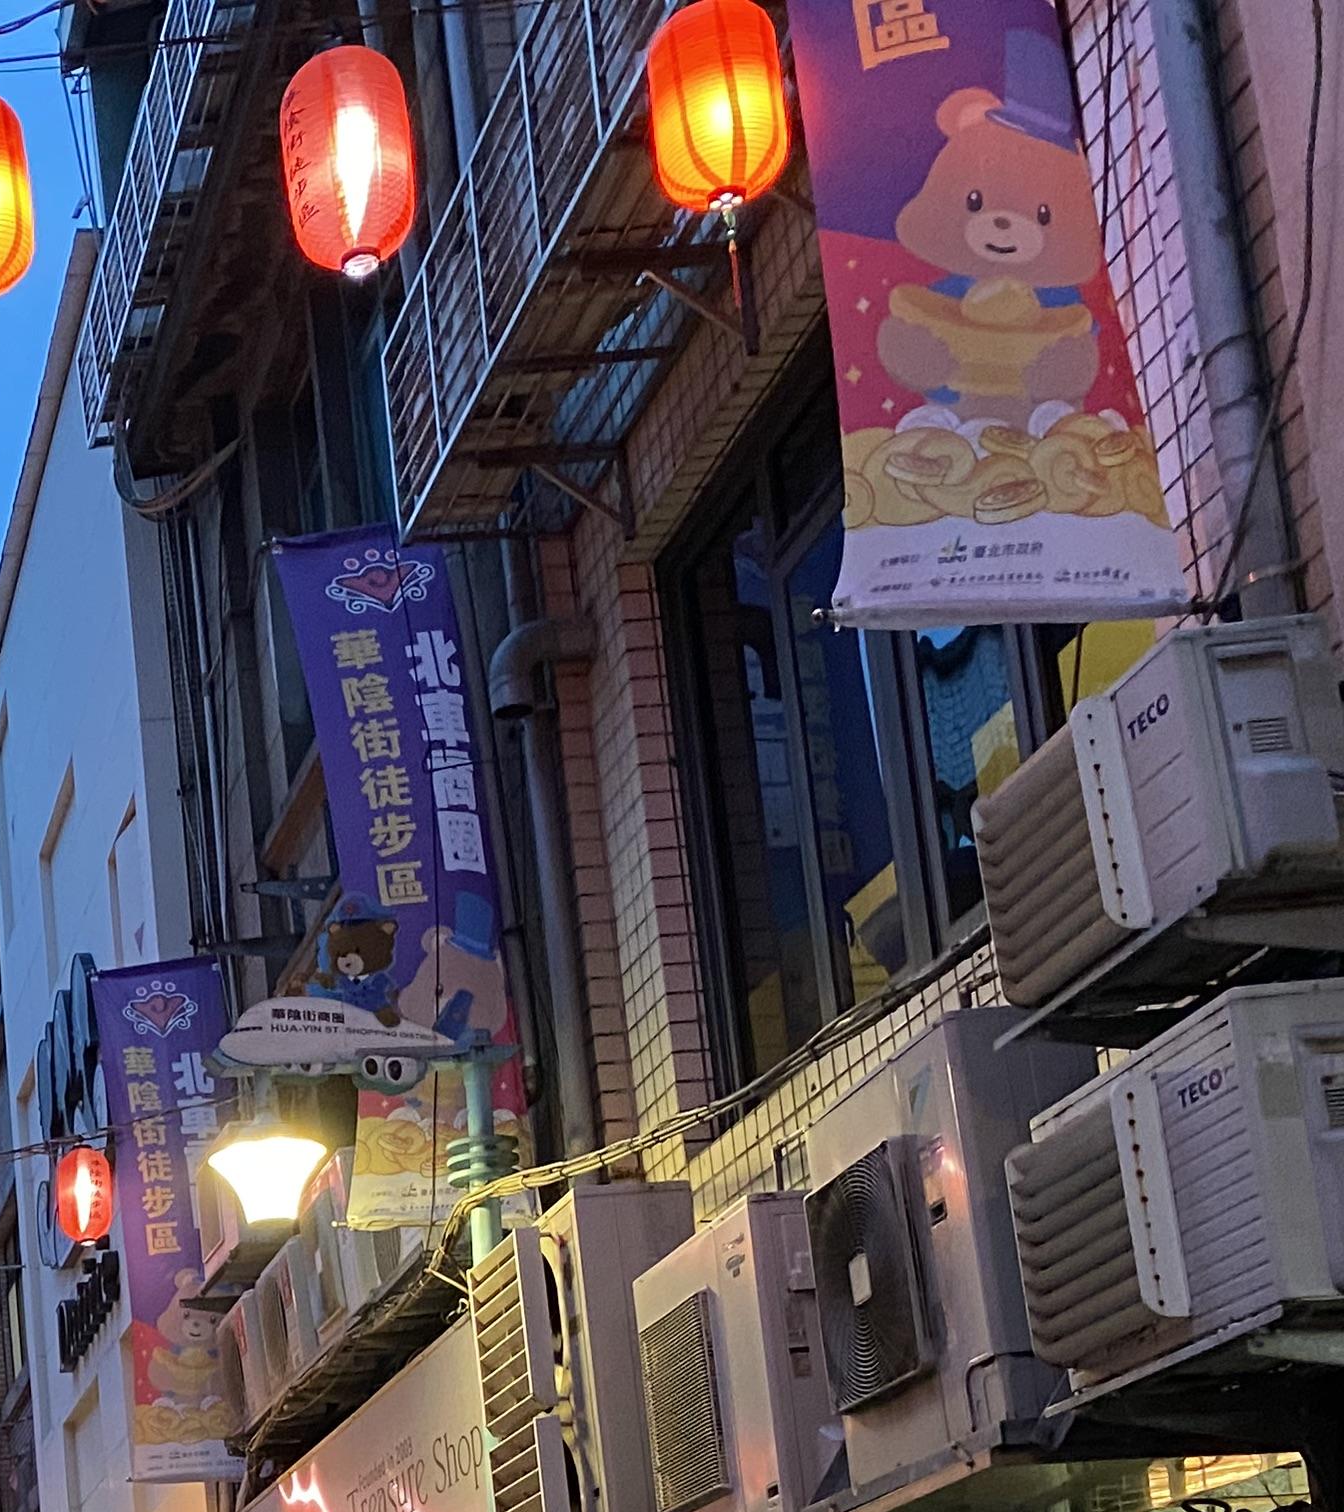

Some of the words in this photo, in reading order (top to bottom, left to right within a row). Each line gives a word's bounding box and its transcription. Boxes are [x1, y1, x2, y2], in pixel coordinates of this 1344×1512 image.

[1126, 694, 1171, 741] TECO
[330, 629, 429, 907] 華陰街徒步區
[405, 629, 488, 875] 北車商圈
[270, 1023, 322, 1034] HUA-YIN
[271, 1008, 345, 1024] 華陰街商圈
[1177, 1067, 1224, 1109] TECO
[122, 1046, 181, 1256] 華陰街徒步區
[433, 1425, 484, 1494] Shop
